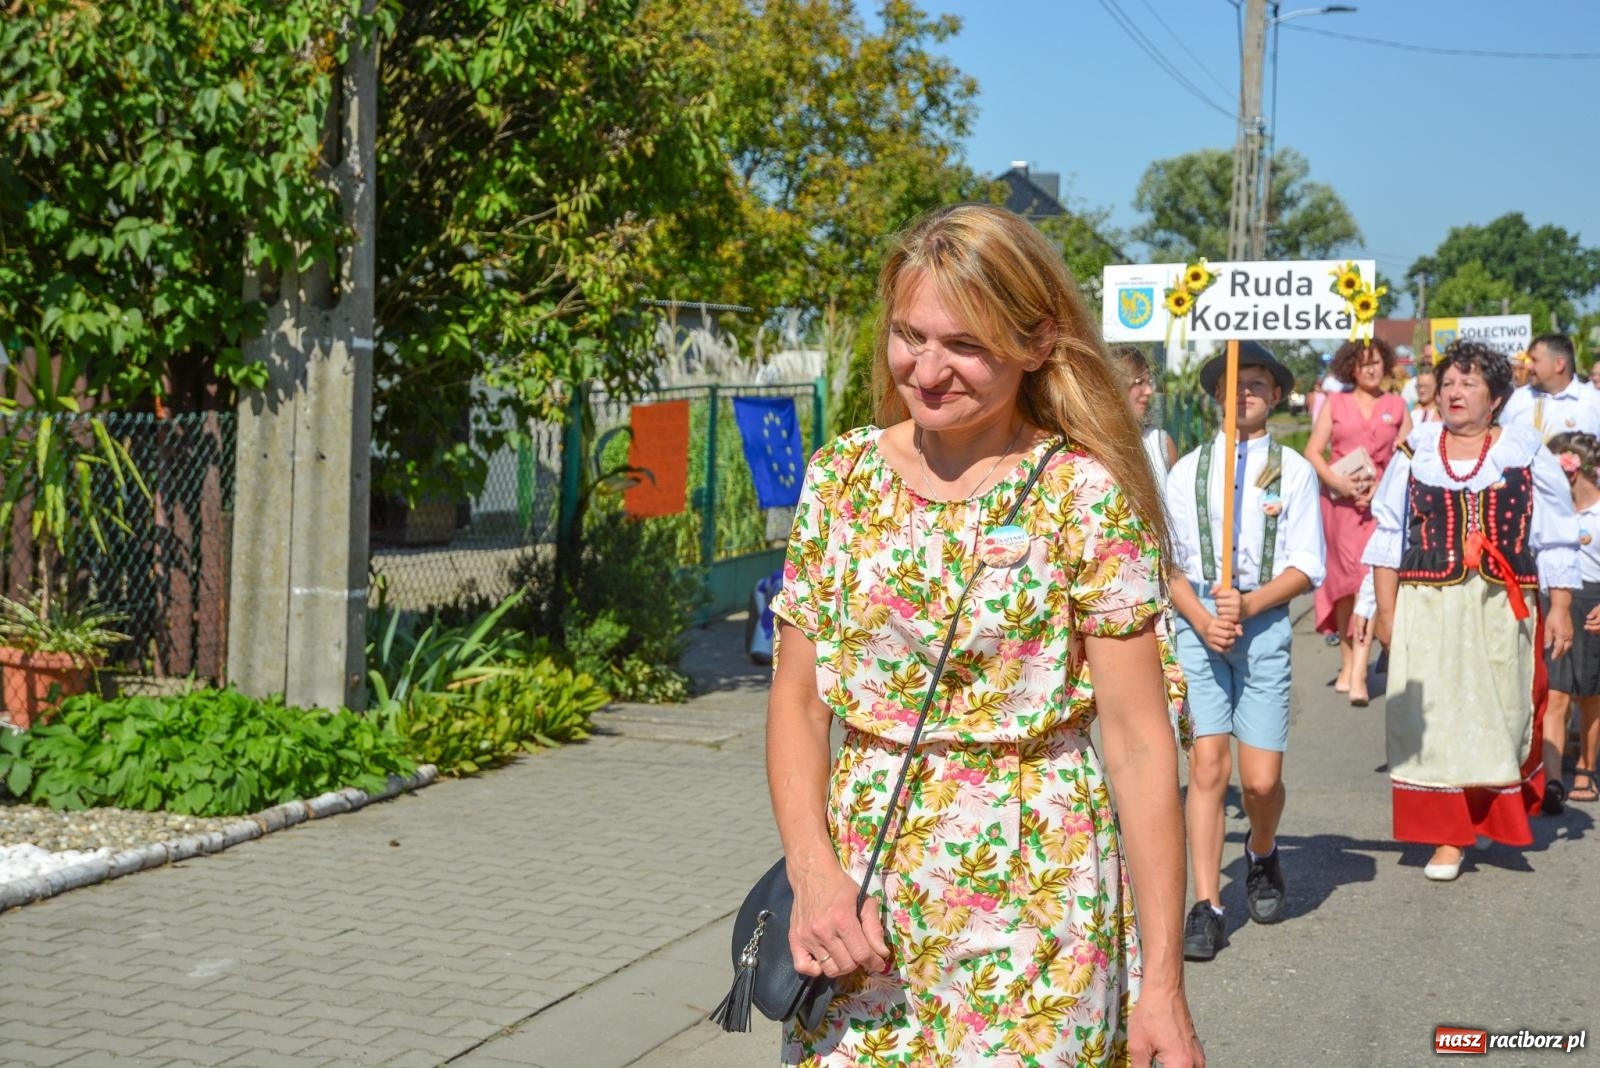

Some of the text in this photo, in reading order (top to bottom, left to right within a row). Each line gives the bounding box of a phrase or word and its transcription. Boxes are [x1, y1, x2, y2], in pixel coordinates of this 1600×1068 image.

[1230, 270, 1313, 297] Ruda
[1191, 304, 1352, 331] Kozielska
[1460, 325, 1527, 338] SOŁECTWO
